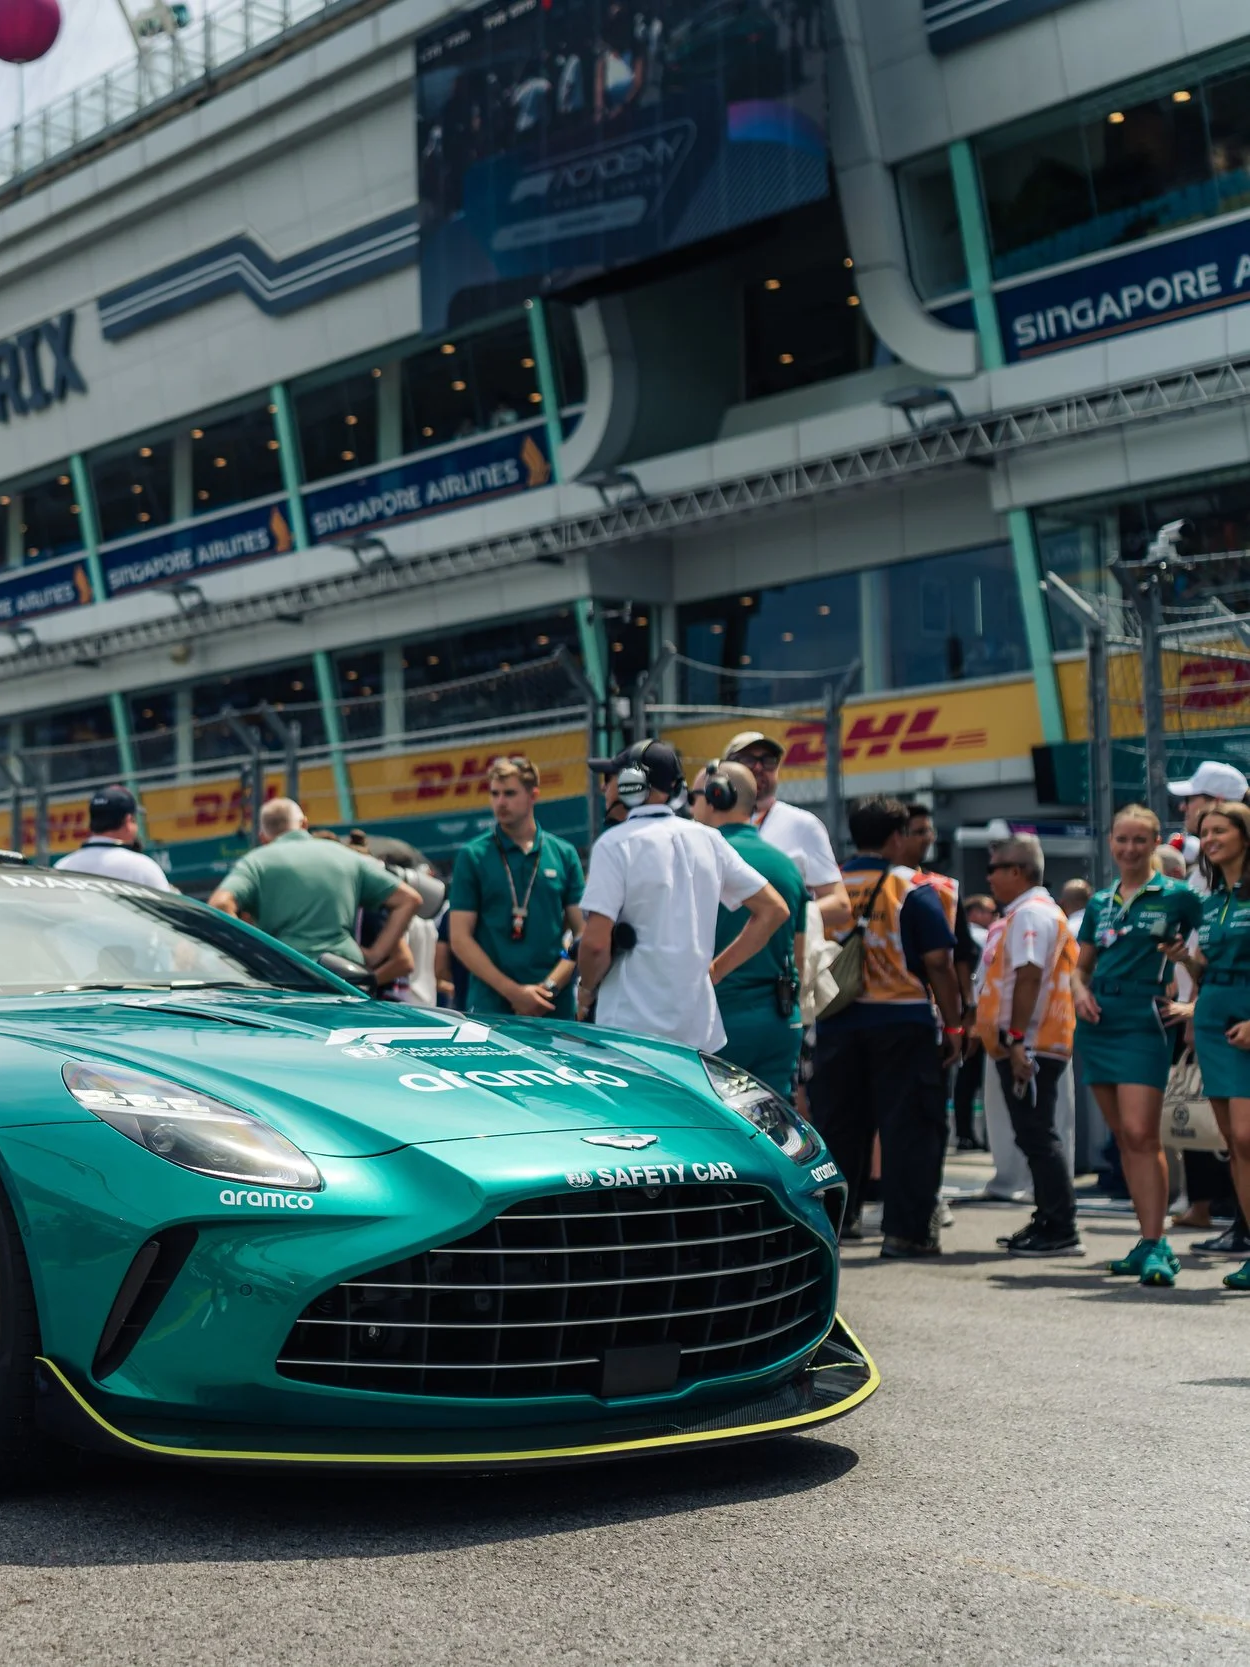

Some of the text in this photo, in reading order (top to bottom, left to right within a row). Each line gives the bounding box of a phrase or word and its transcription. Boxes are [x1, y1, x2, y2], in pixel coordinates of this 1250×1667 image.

[1012, 263, 1222, 346] SINGAPORE
[312, 458, 519, 533] SINGAPORE AIRLINES
[107, 527, 270, 589] SINGAPORE AIRLINES
[783, 706, 951, 766] DHL
[413, 750, 526, 800] DH
[0, 874, 162, 900] MARTIN
[398, 1066, 630, 1093] aramco
[596, 1164, 685, 1187] SAFETY
[691, 1161, 738, 1182] CAR
[219, 1189, 314, 1210] aramco
